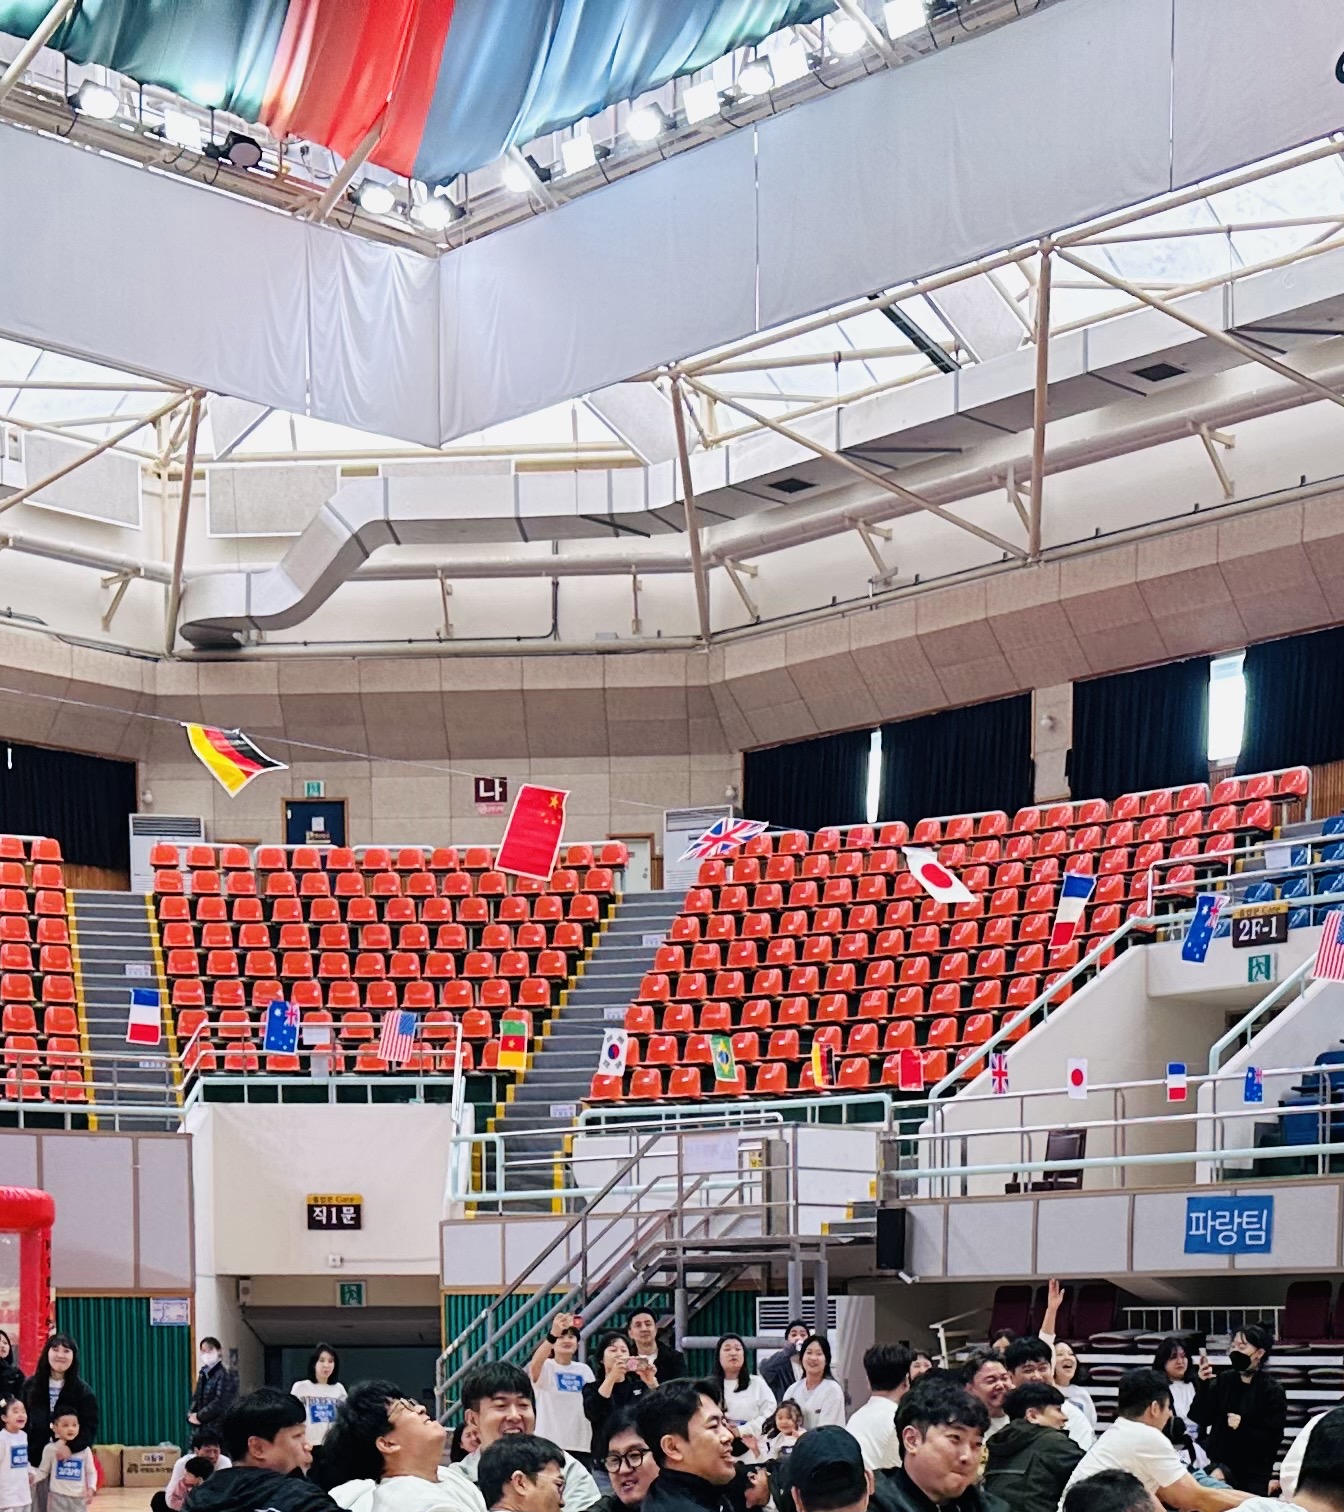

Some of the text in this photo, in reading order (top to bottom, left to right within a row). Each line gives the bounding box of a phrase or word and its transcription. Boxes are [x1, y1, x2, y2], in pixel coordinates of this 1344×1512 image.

[479, 778, 504, 801] 나
[1239, 916, 1277, 941] 2F-1
[312, 1206, 357, 1225] 직1문
[1188, 1209, 1268, 1246] 파랑팀
